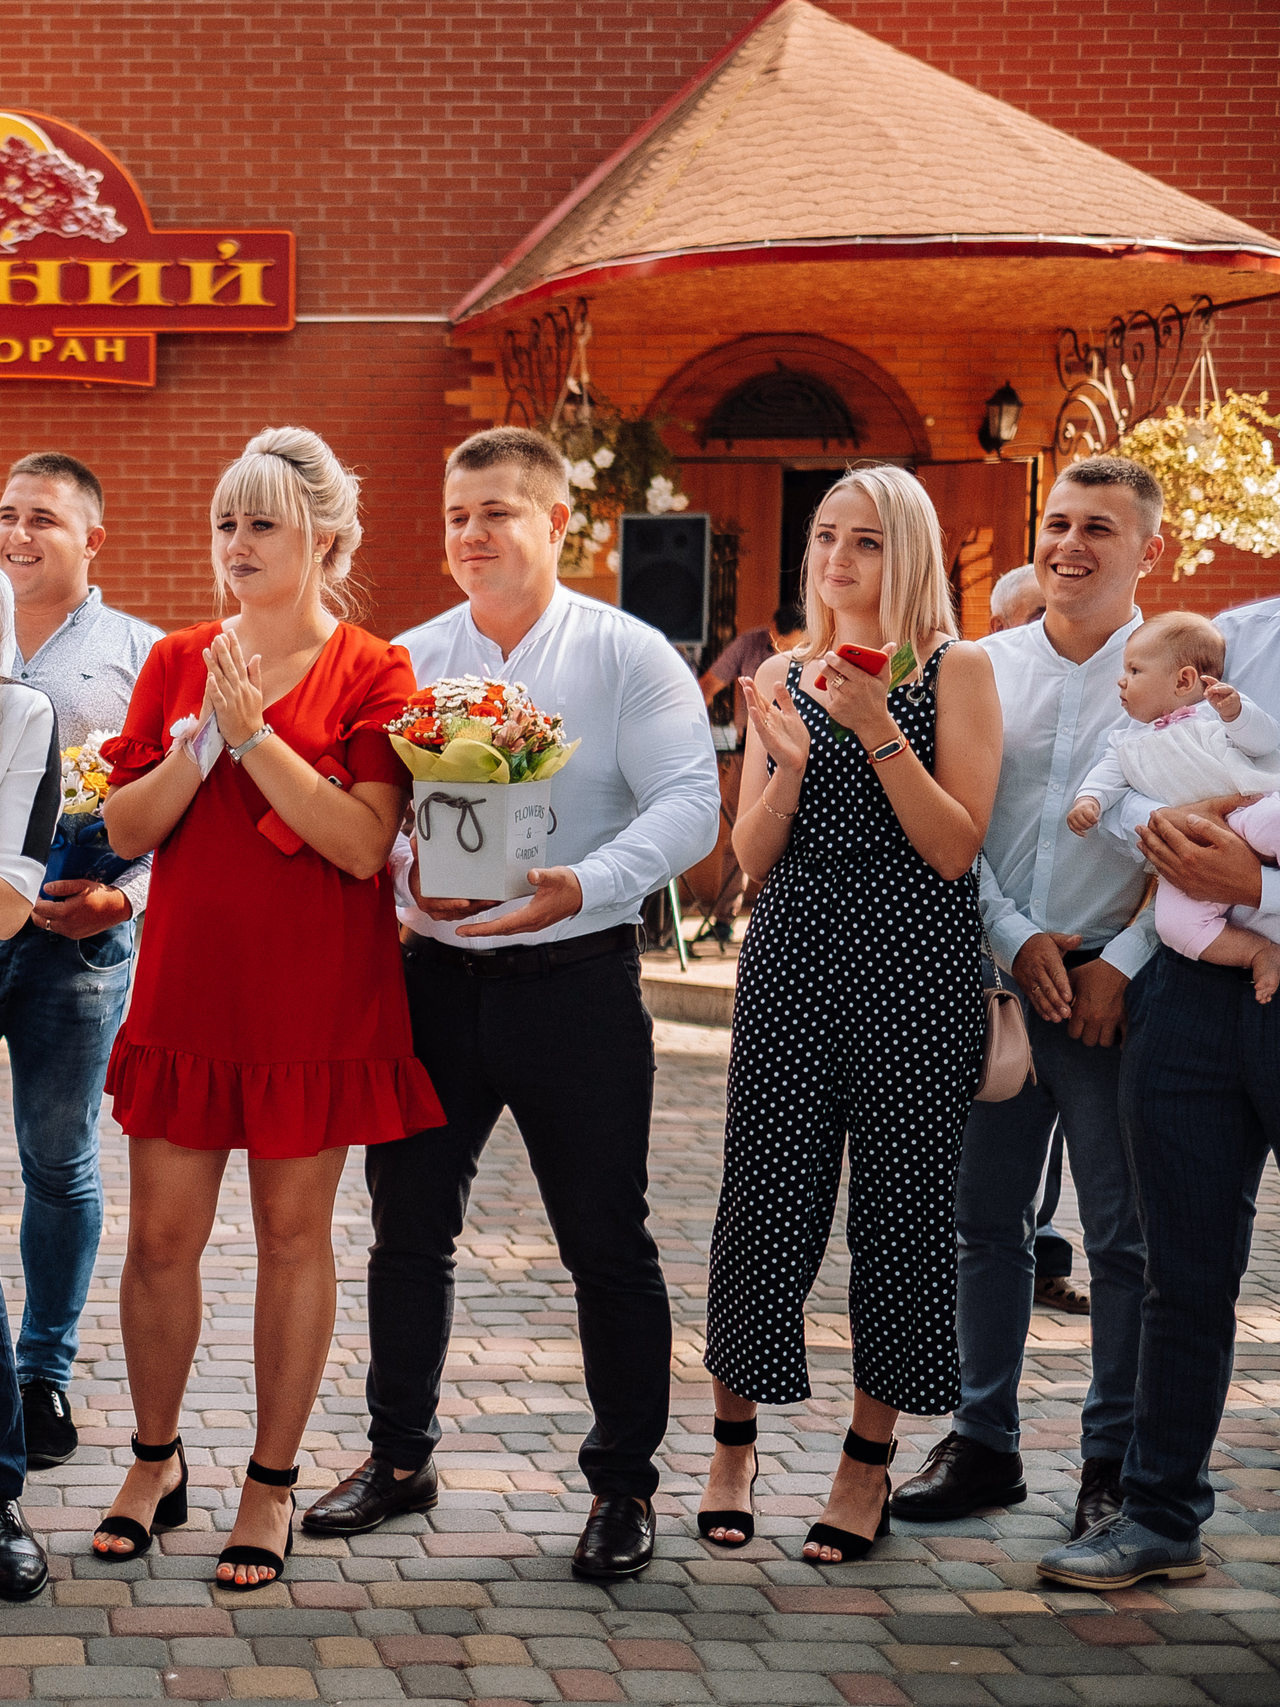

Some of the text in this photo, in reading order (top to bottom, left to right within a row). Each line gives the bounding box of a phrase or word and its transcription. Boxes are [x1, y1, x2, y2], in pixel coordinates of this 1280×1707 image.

[514, 805, 545, 824] FLOWERS
[526, 827, 532, 839] &
[515, 845, 539, 861] GARDEN
